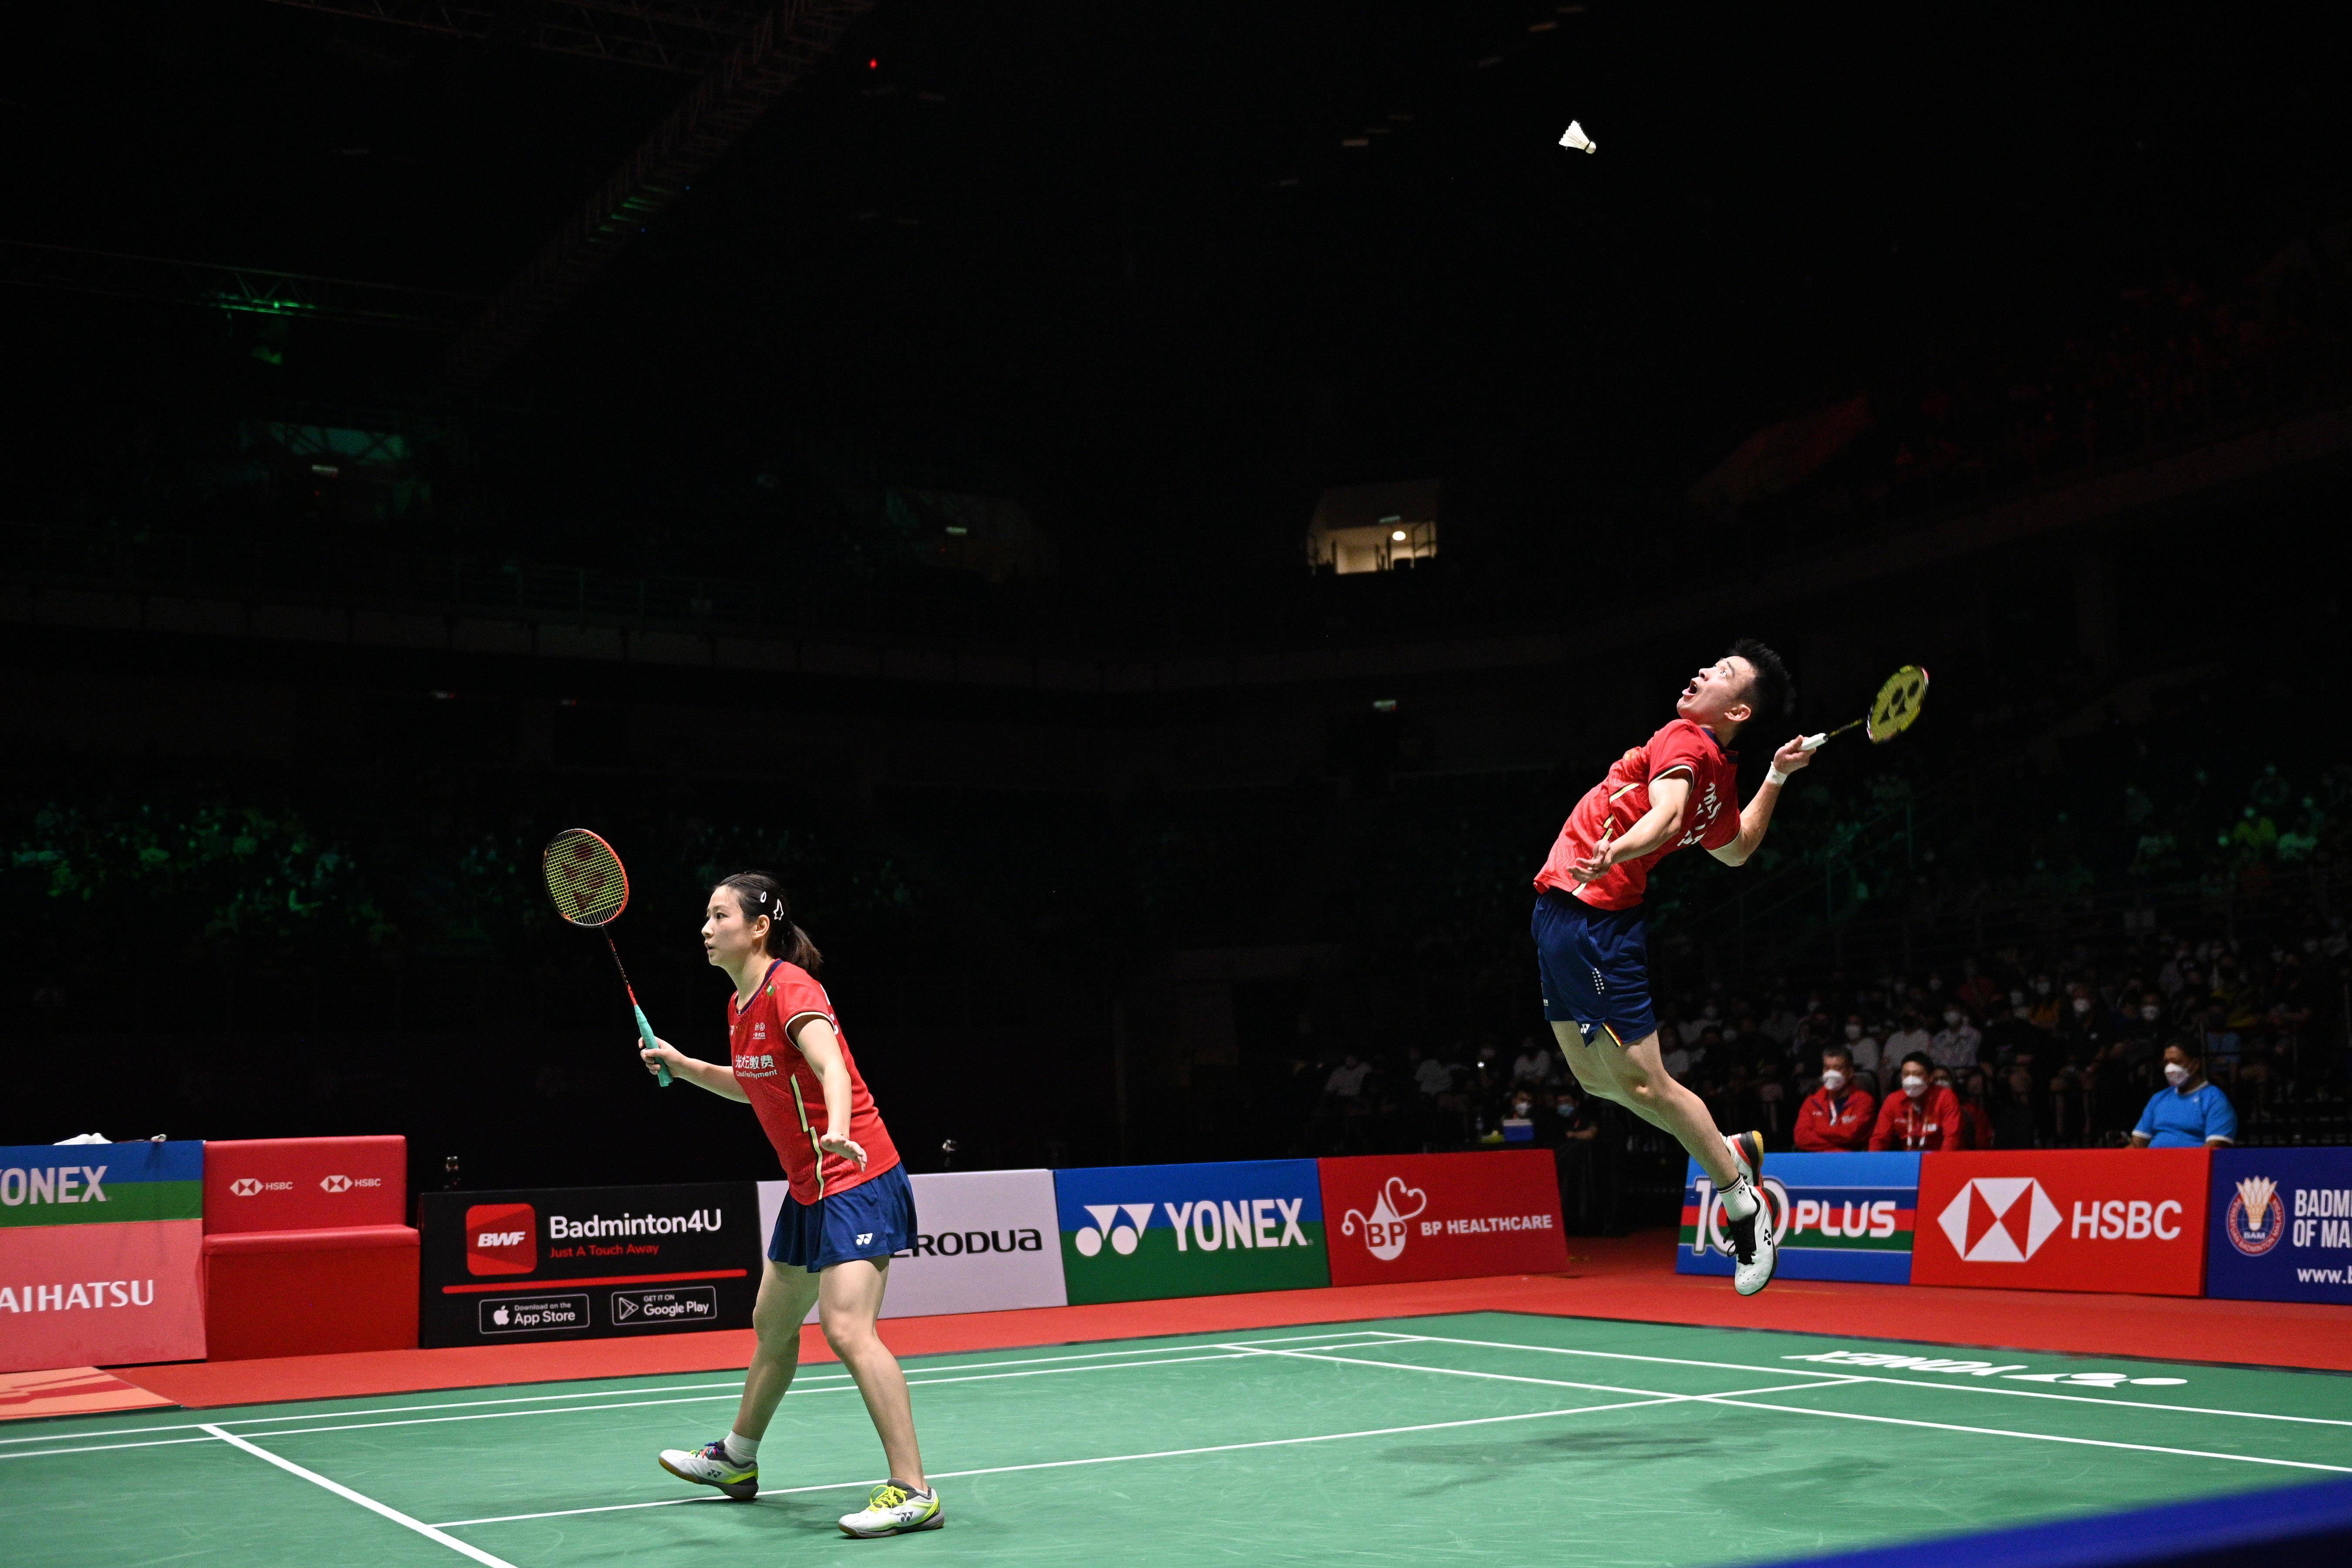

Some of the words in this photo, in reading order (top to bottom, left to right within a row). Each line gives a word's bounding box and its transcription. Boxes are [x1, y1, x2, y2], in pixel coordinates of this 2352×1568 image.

[0, 1166, 108, 1206] ONEX
[266, 1182, 293, 1190] HSBC
[355, 1178, 381, 1187] HSBC
[550, 1209, 721, 1239] Badminton4U
[1164, 1198, 1307, 1251] YONEX
[1421, 1221, 1442, 1236] BP
[1447, 1215, 1553, 1234] HEALTHCARE
[2072, 1200, 2182, 1240] HSBC
[478, 1232, 526, 1247] BWF
[1367, 1221, 1406, 1248] BP
[2293, 1220, 2317, 1247] OF
[2321, 1220, 2352, 1248] MA
[551, 1247, 573, 1258] Just
[576, 1246, 586, 1257] A
[588, 1244, 623, 1256] Touch
[626, 1244, 659, 1255] Away
[514, 1312, 540, 1326] App
[543, 1310, 575, 1323] Store
[643, 1302, 685, 1317] Google
[686, 1301, 709, 1315] Play
[1780, 1350, 2028, 1375] YONEX
